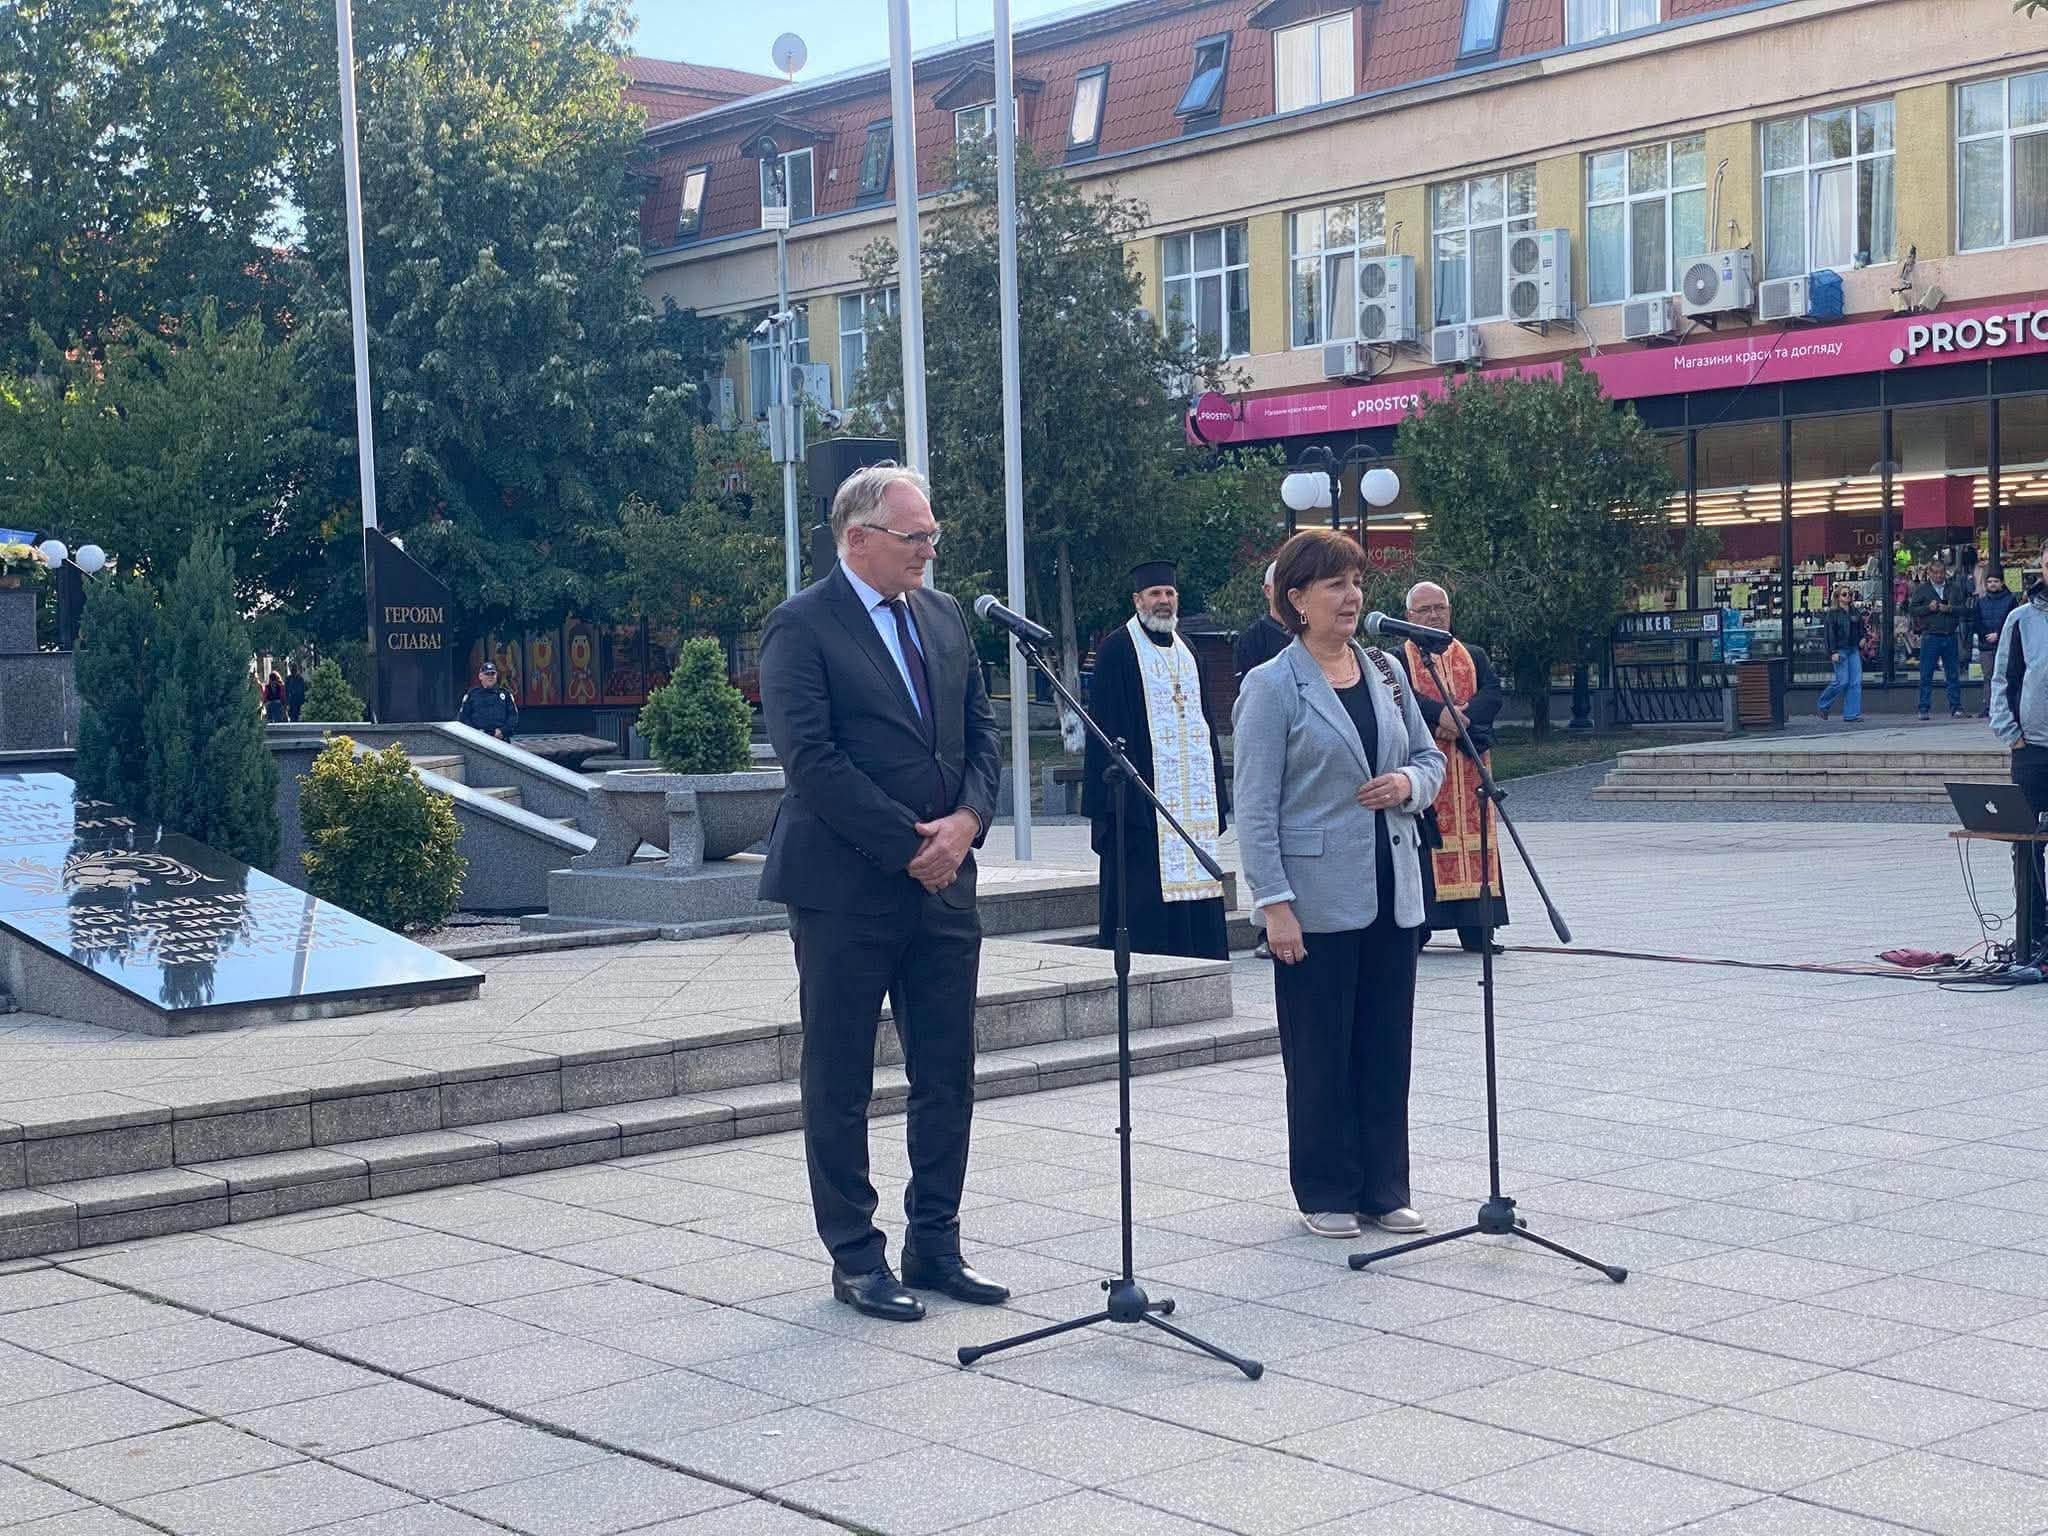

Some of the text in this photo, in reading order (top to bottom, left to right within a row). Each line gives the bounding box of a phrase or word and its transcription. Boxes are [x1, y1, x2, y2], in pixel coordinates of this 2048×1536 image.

[1674, 342, 1843, 369] Магазини краси та догляду
[384, 606, 443, 624] ГЕРОЯМ
[388, 632, 441, 650] СЛАВА!
[129, 896, 212, 911] ДАЙ,
[131, 905, 240, 921] КРОВІ,
